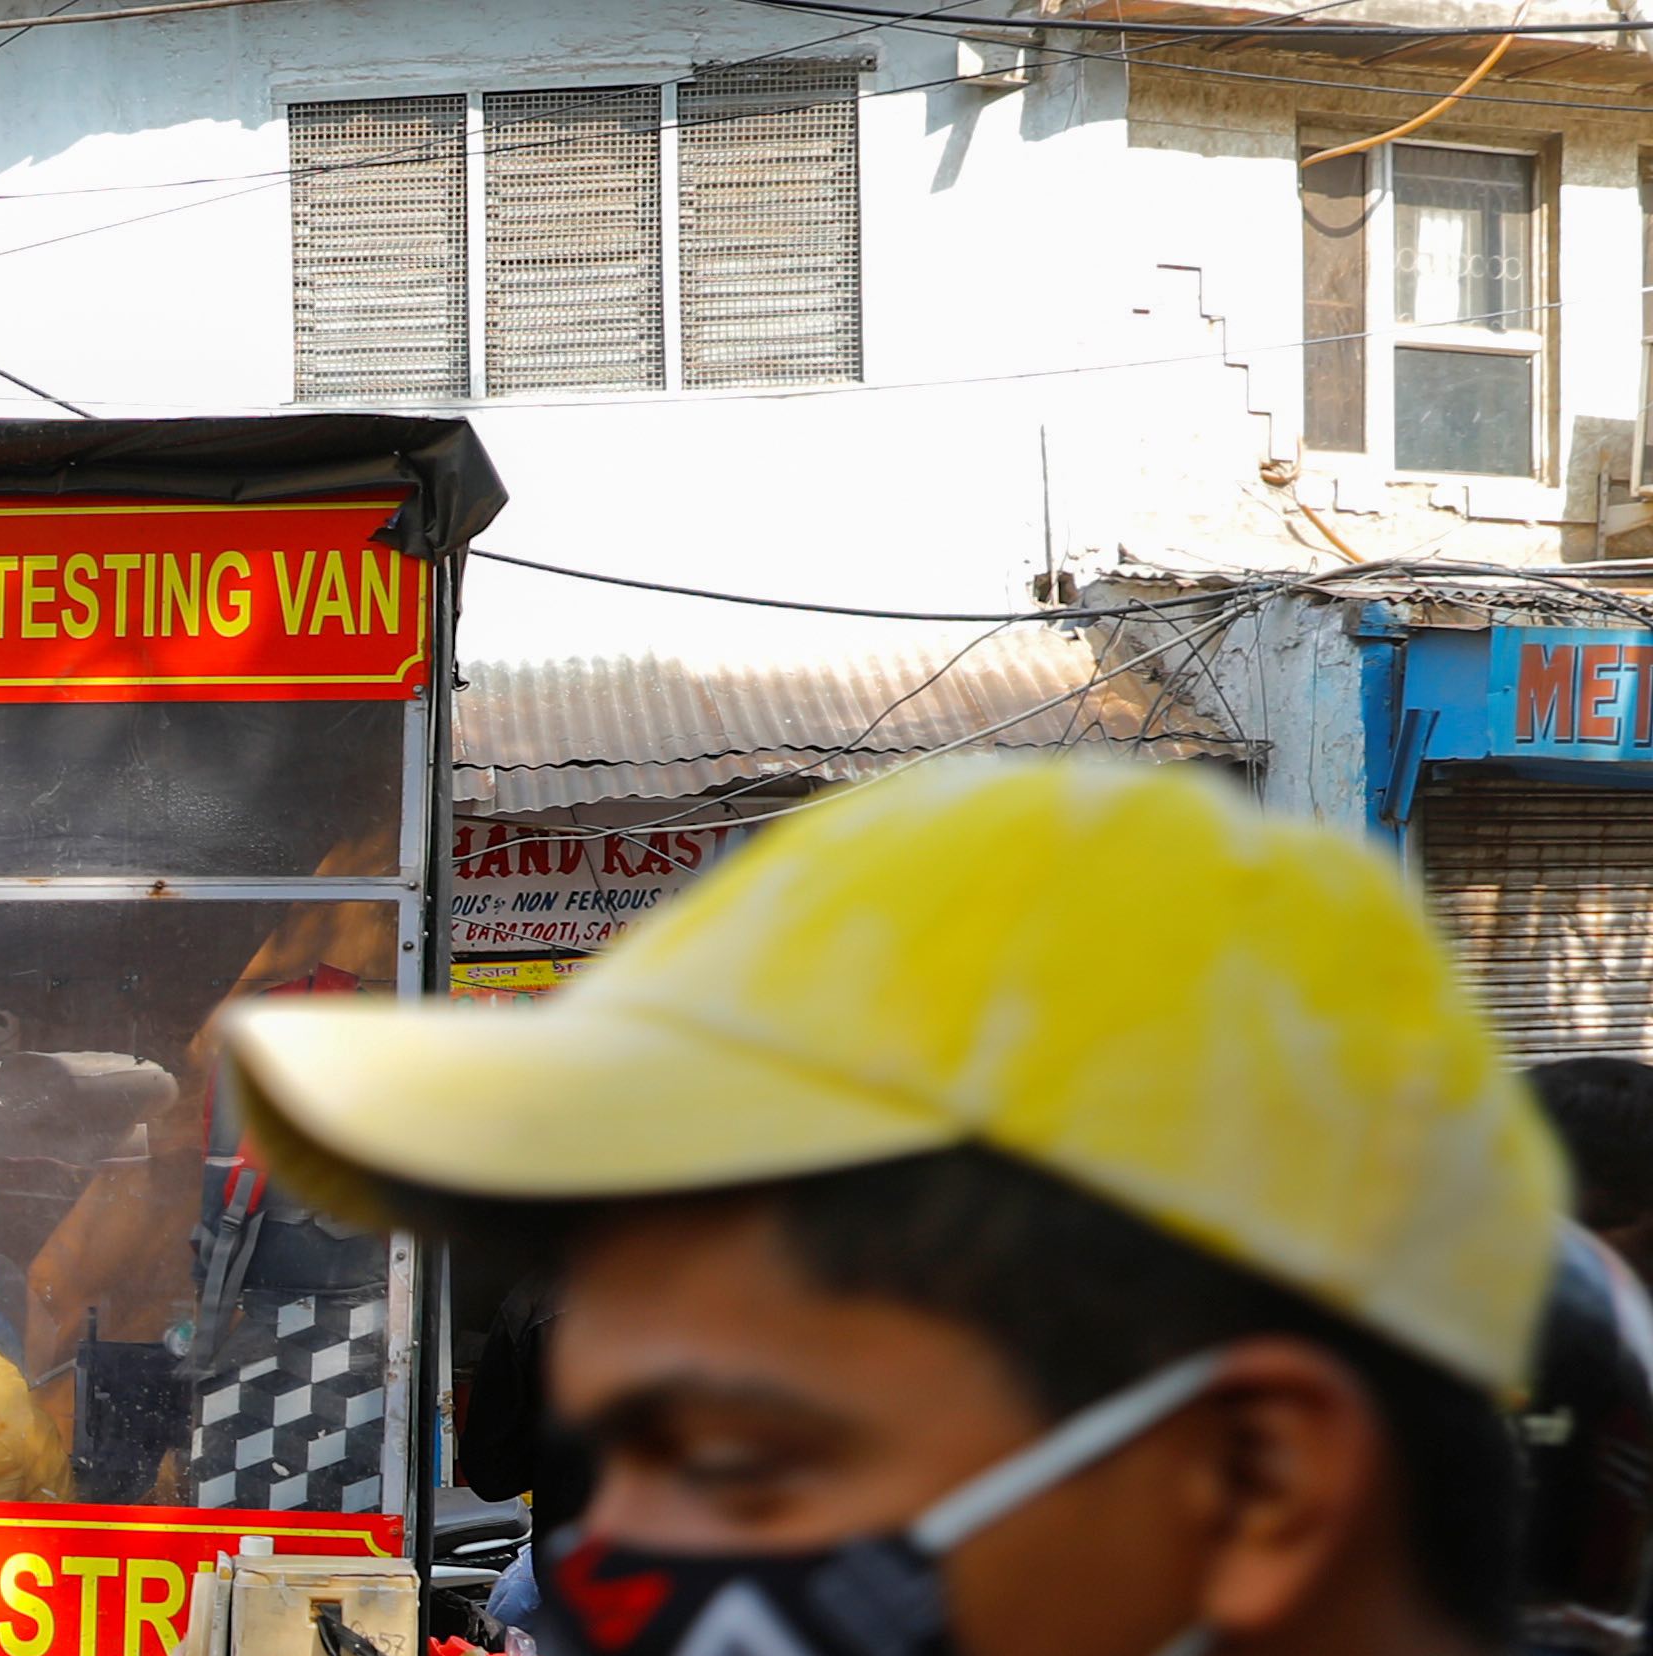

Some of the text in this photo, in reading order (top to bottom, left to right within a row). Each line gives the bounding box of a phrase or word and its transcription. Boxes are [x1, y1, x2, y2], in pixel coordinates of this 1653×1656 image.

[270, 546, 401, 636] VAN
[511, 891, 557, 912] NON
[565, 887, 664, 915] FERROUS
